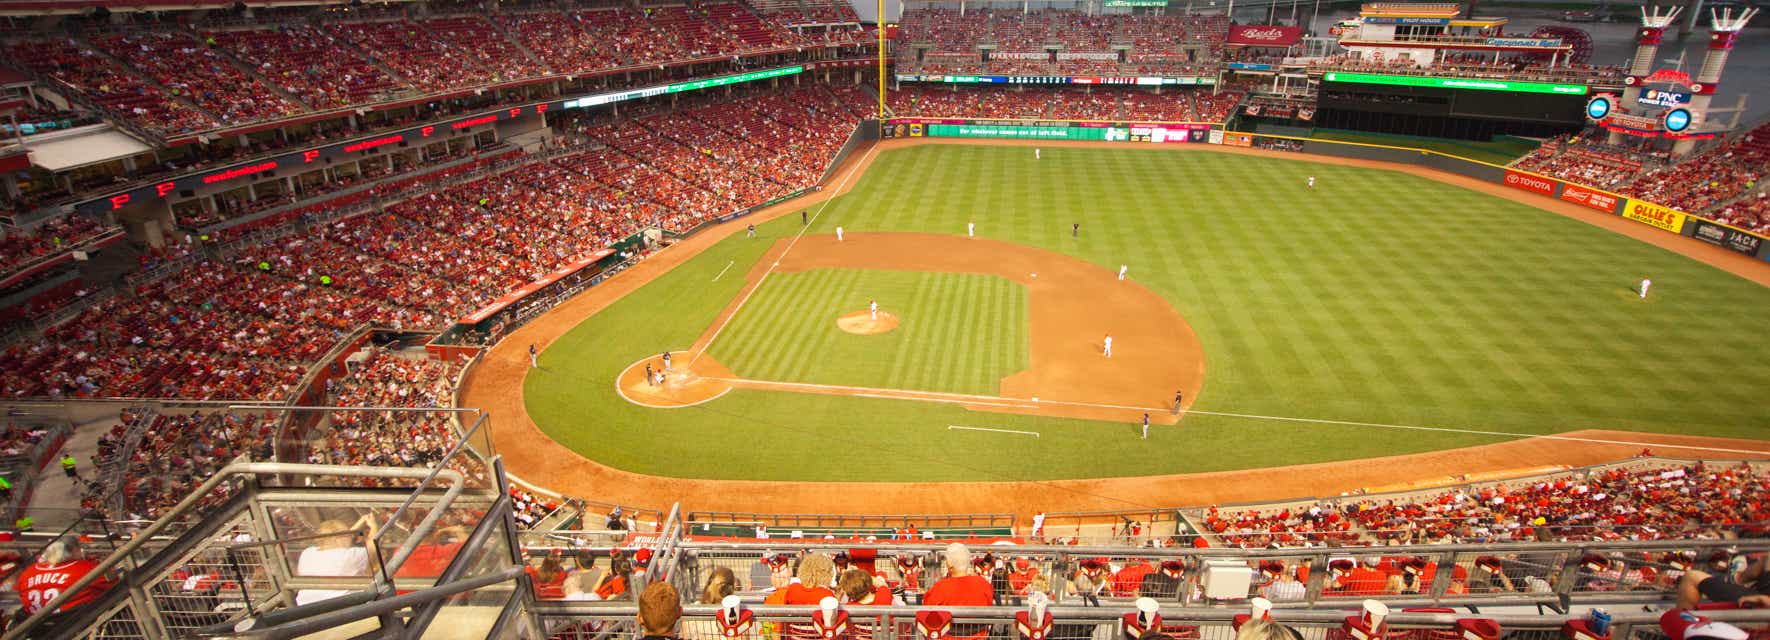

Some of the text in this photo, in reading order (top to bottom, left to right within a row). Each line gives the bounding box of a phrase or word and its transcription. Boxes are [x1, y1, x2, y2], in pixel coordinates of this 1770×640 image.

[1240, 28, 1283, 38] Reds
[1656, 91, 1682, 102] PNC
[1519, 177, 1551, 191] TOYOTA
[1634, 204, 1675, 225] OLLIE'S
[1653, 219, 1675, 231] OUTLET
[1729, 231, 1759, 248] JACK
[28, 572, 70, 588] BRUCE
